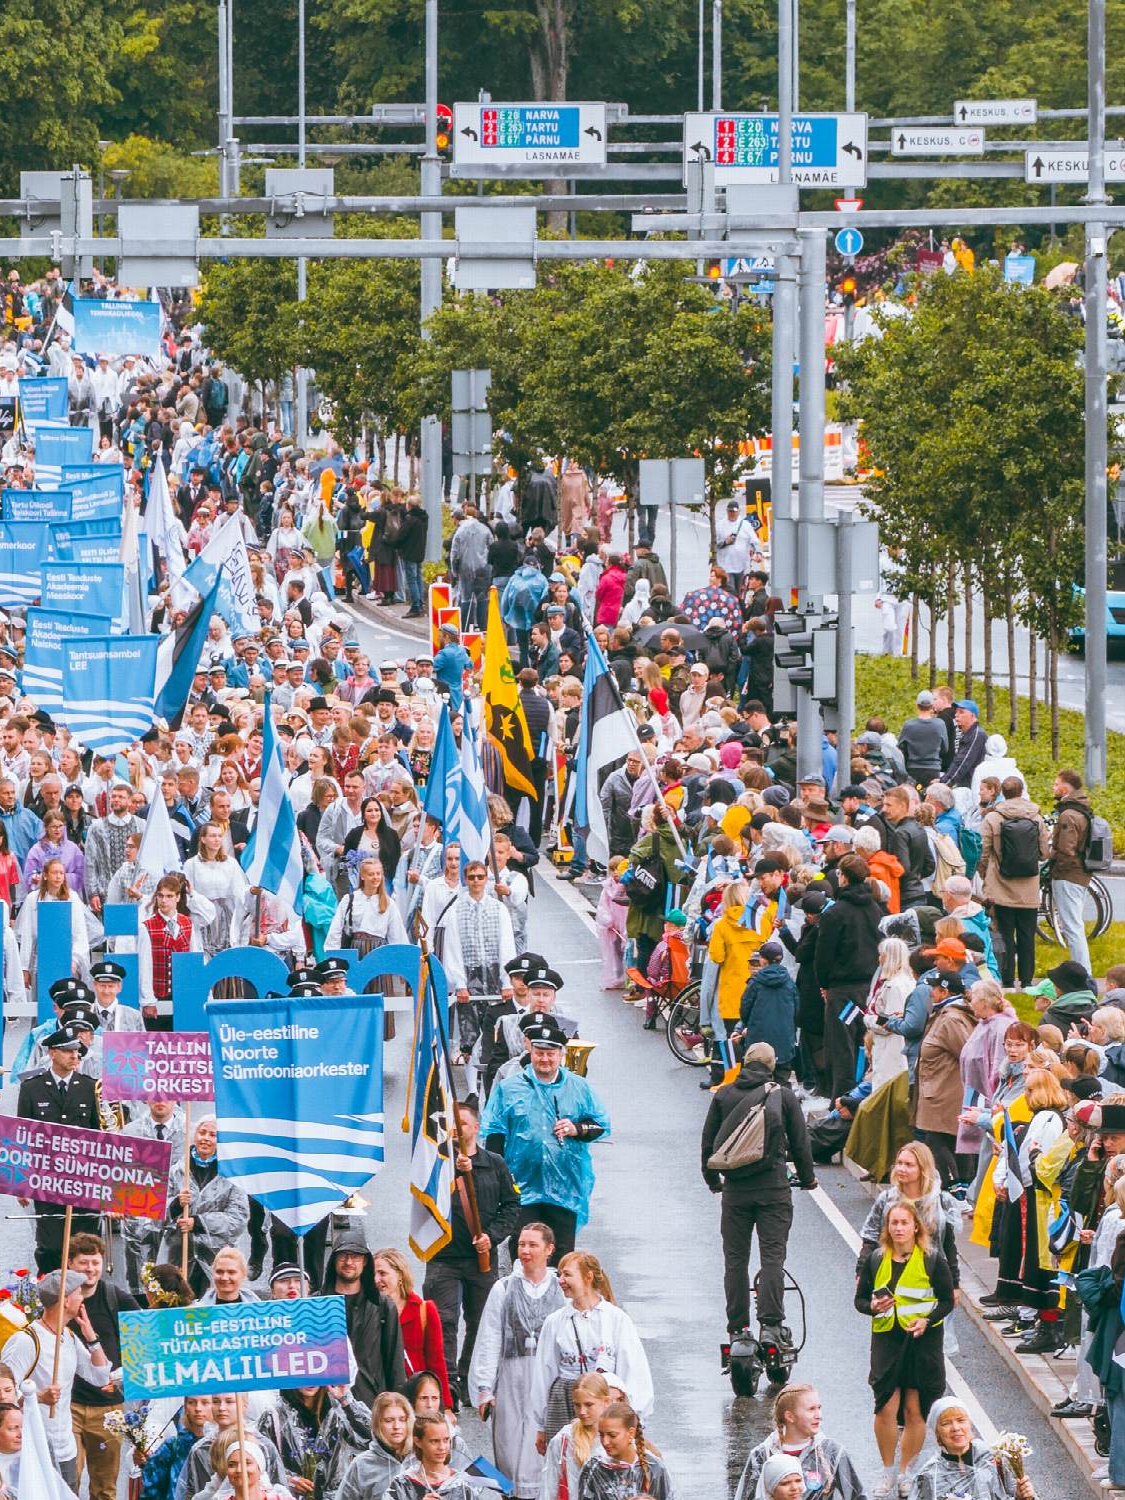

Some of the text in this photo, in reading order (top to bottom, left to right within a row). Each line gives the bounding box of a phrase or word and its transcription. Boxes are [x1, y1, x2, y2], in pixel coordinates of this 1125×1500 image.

[525, 110, 560, 120] NARVA
[525, 122, 559, 133] TARTU
[738, 122, 745, 132] E
[747, 122, 761, 132] 20
[770, 121, 813, 133] NRVA
[525, 133, 561, 145] PÄRNU
[738, 138, 745, 147] E
[748, 137, 767, 148] 263
[525, 150, 581, 161] LASNAMÄE
[738, 152, 745, 162] E
[747, 152, 760, 162] 67
[1048, 160, 1117, 172] KESKU C
[770, 171, 838, 183] LNAMÄE
[46, 573, 103, 583] Eesti Teaduste
[46, 583, 90, 592] Akadeemia
[46, 591, 85, 601] Meeskoor
[32, 619, 89, 634] Eesti Teaduste
[69, 649, 141, 661] Tantsuansambel
[69, 660, 88, 671] LEE
[634, 864, 657, 890] VANS
[220, 1023, 319, 1043] Üle-eestiline
[222, 1045, 278, 1062] Noorte
[222, 1061, 370, 1080] Sümfooniaorkester
[143, 1078, 215, 1094] ORKEST
[15, 1125, 134, 1164] ÜLE-EESTILINE
[54, 1153, 162, 1188] SÜMFOONIA-
[28, 1173, 113, 1202] ORKESTER
[174, 1315, 293, 1337] ÜLE-EESTILINE
[160, 1331, 308, 1356] TÜTARLASTEKOOR
[143, 1349, 329, 1388] ILMALILLED
